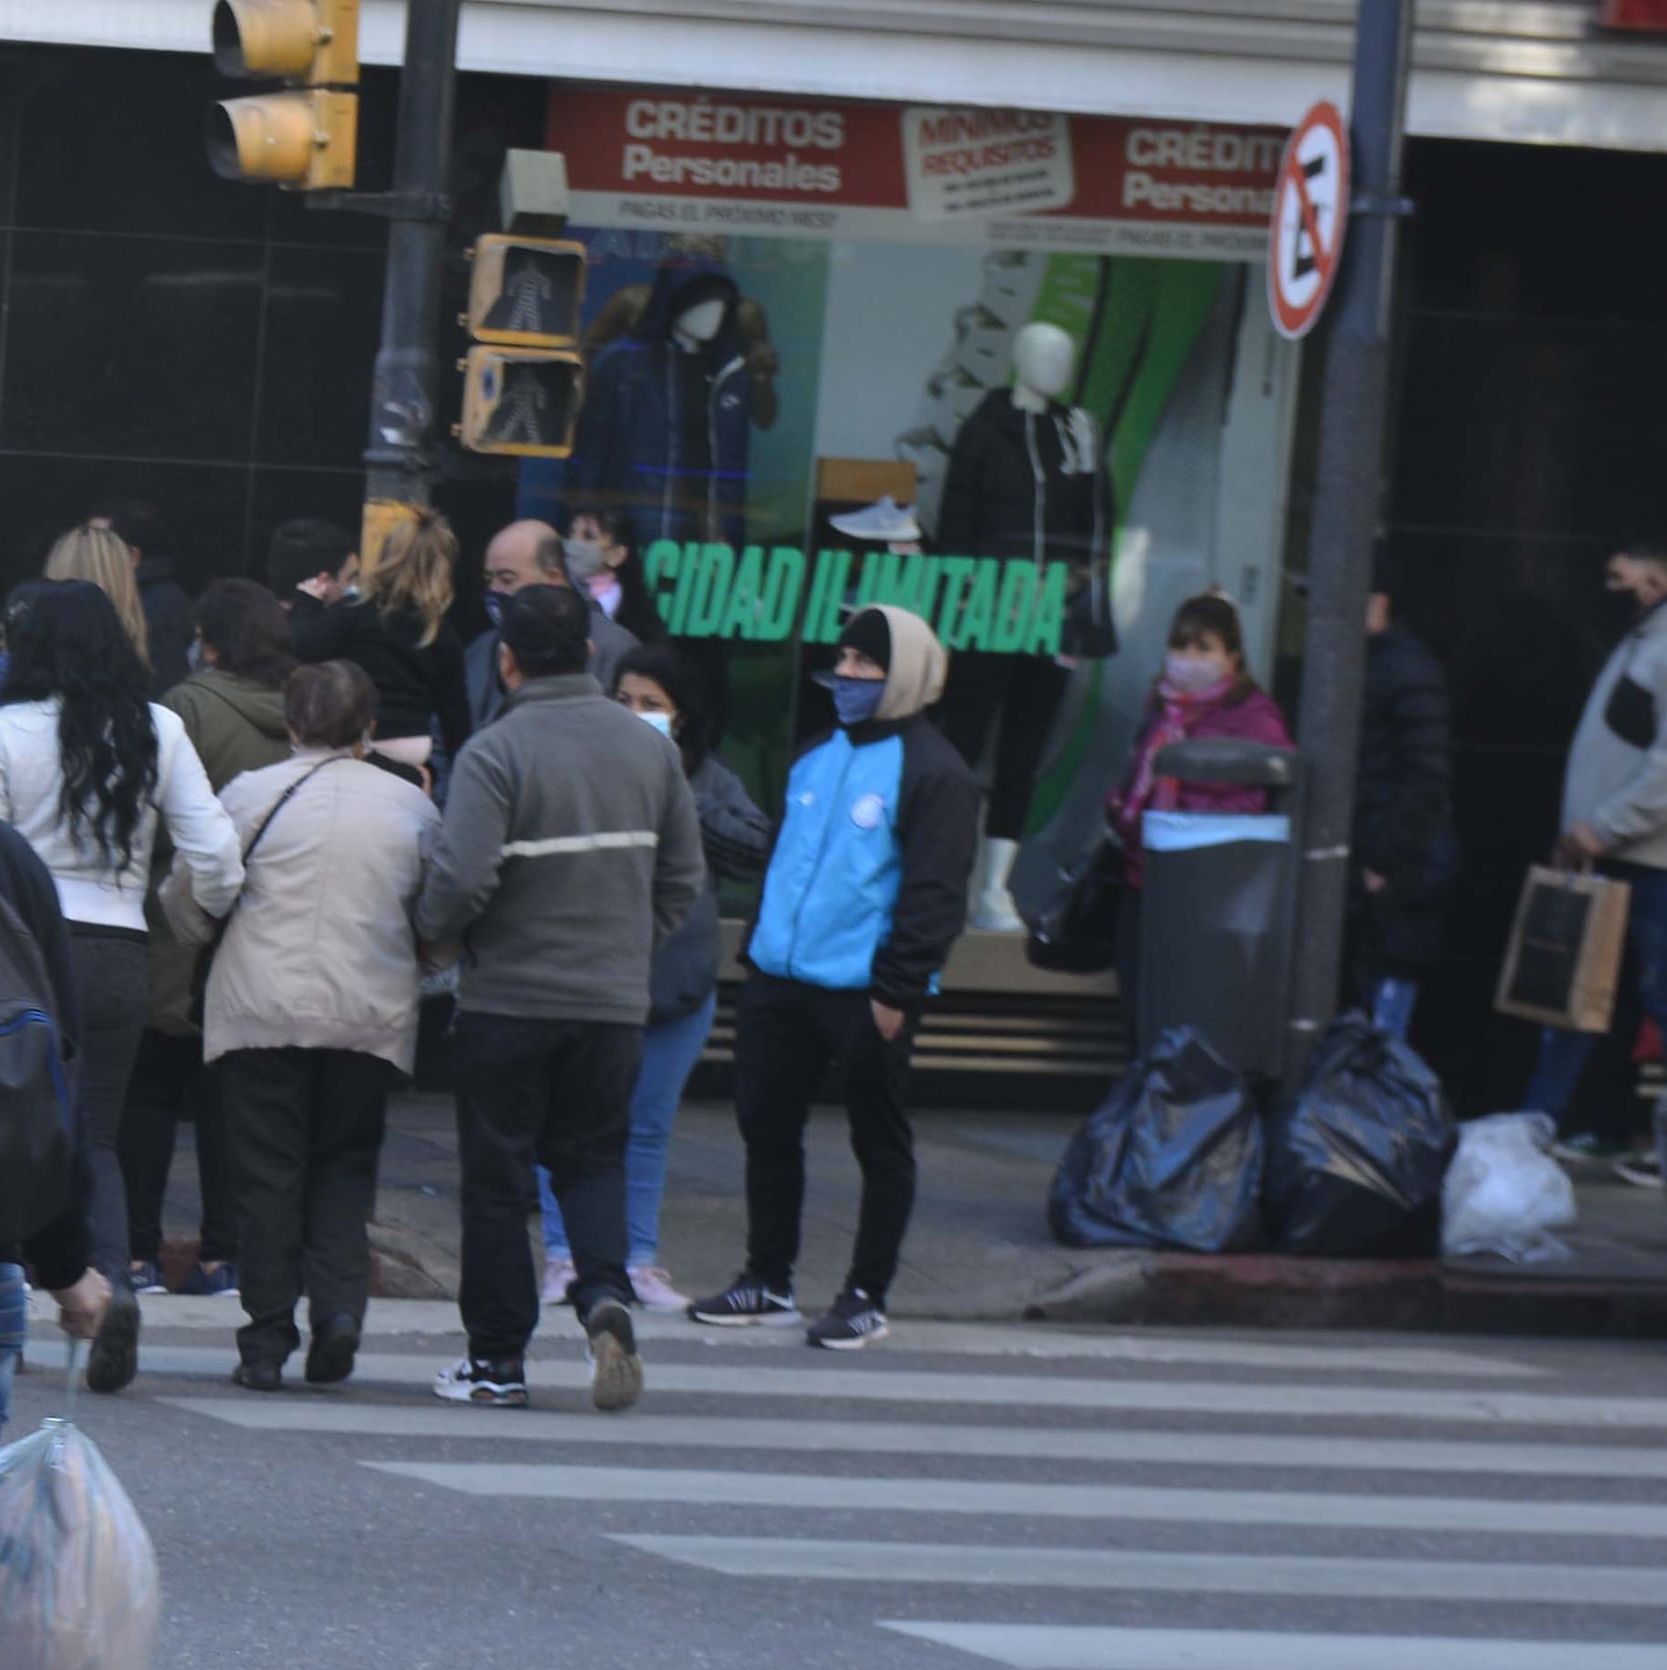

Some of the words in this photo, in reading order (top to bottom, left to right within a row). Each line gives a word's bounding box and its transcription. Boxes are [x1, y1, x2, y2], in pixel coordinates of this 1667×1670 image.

[624, 96, 845, 149] CRÉDITOS
[621, 144, 841, 192] Personales
[1124, 123, 1284, 173] CRÉDIT
[1122, 172, 1278, 214] Persona
[637, 539, 807, 642] CIDAD
